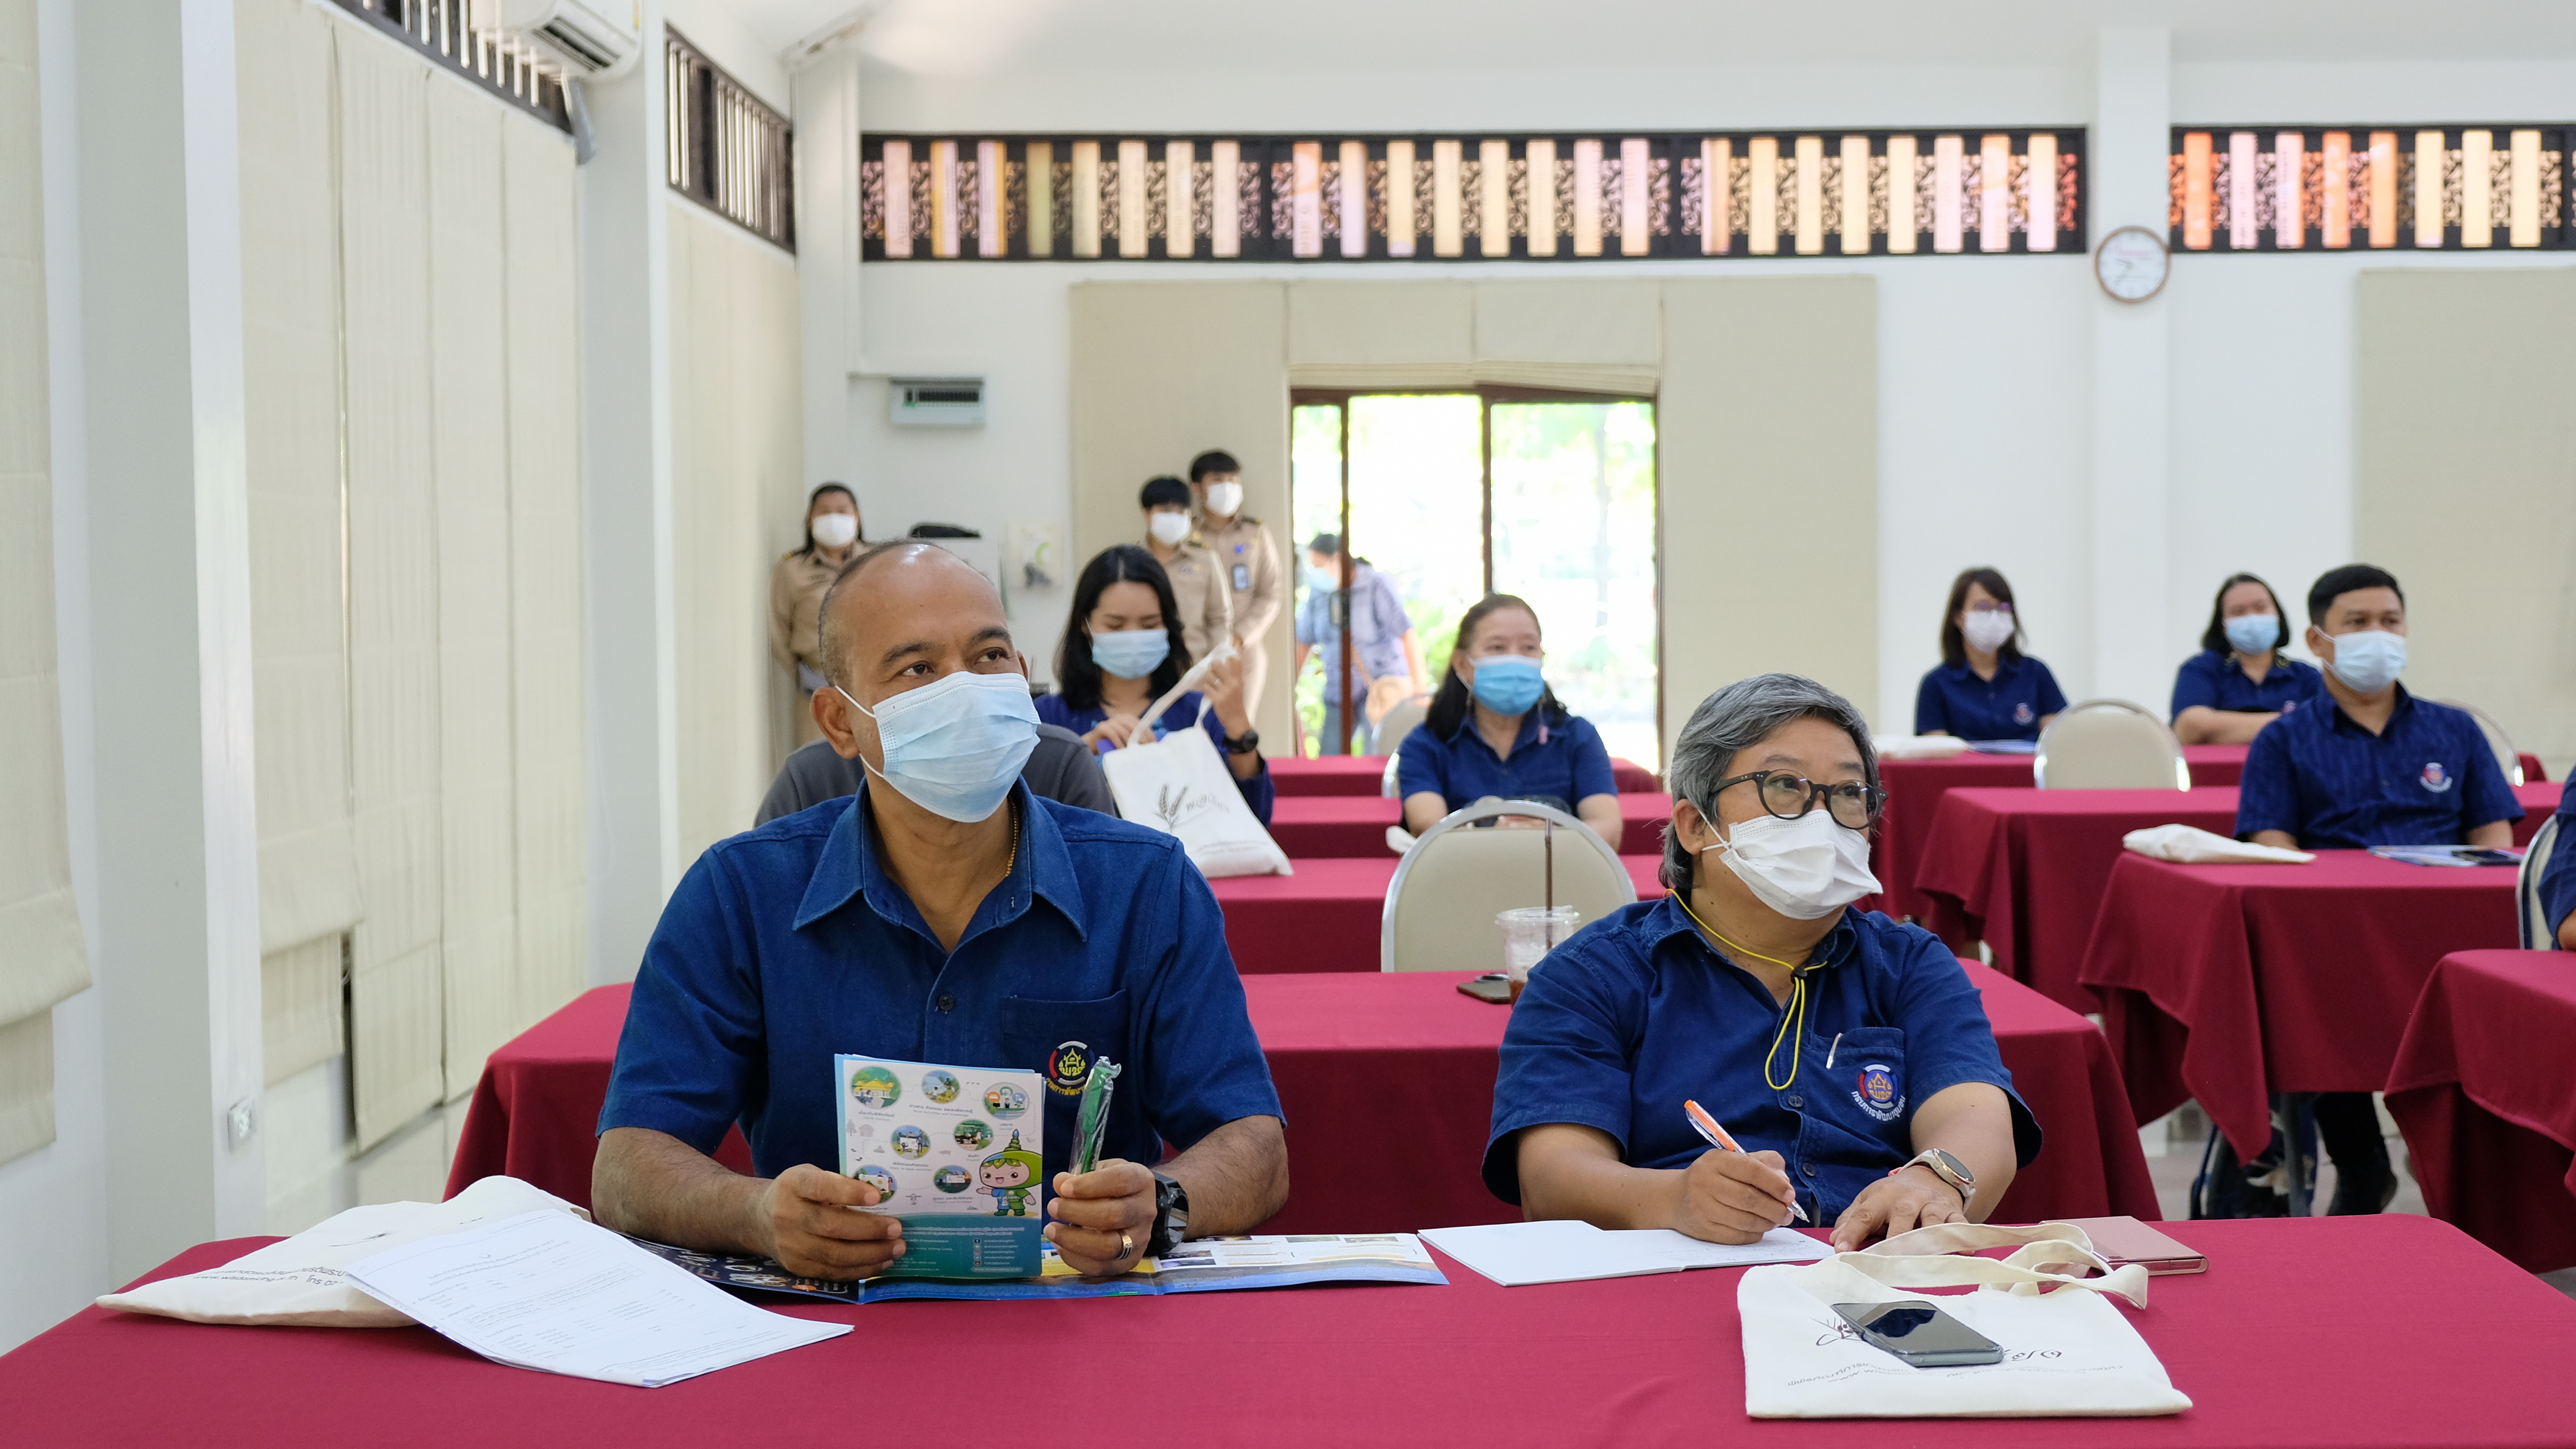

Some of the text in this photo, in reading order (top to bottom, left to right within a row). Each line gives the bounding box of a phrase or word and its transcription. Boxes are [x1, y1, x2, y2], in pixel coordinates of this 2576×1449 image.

[1851, 1091, 1906, 1121] กรมการพัฒนาชุมชน
